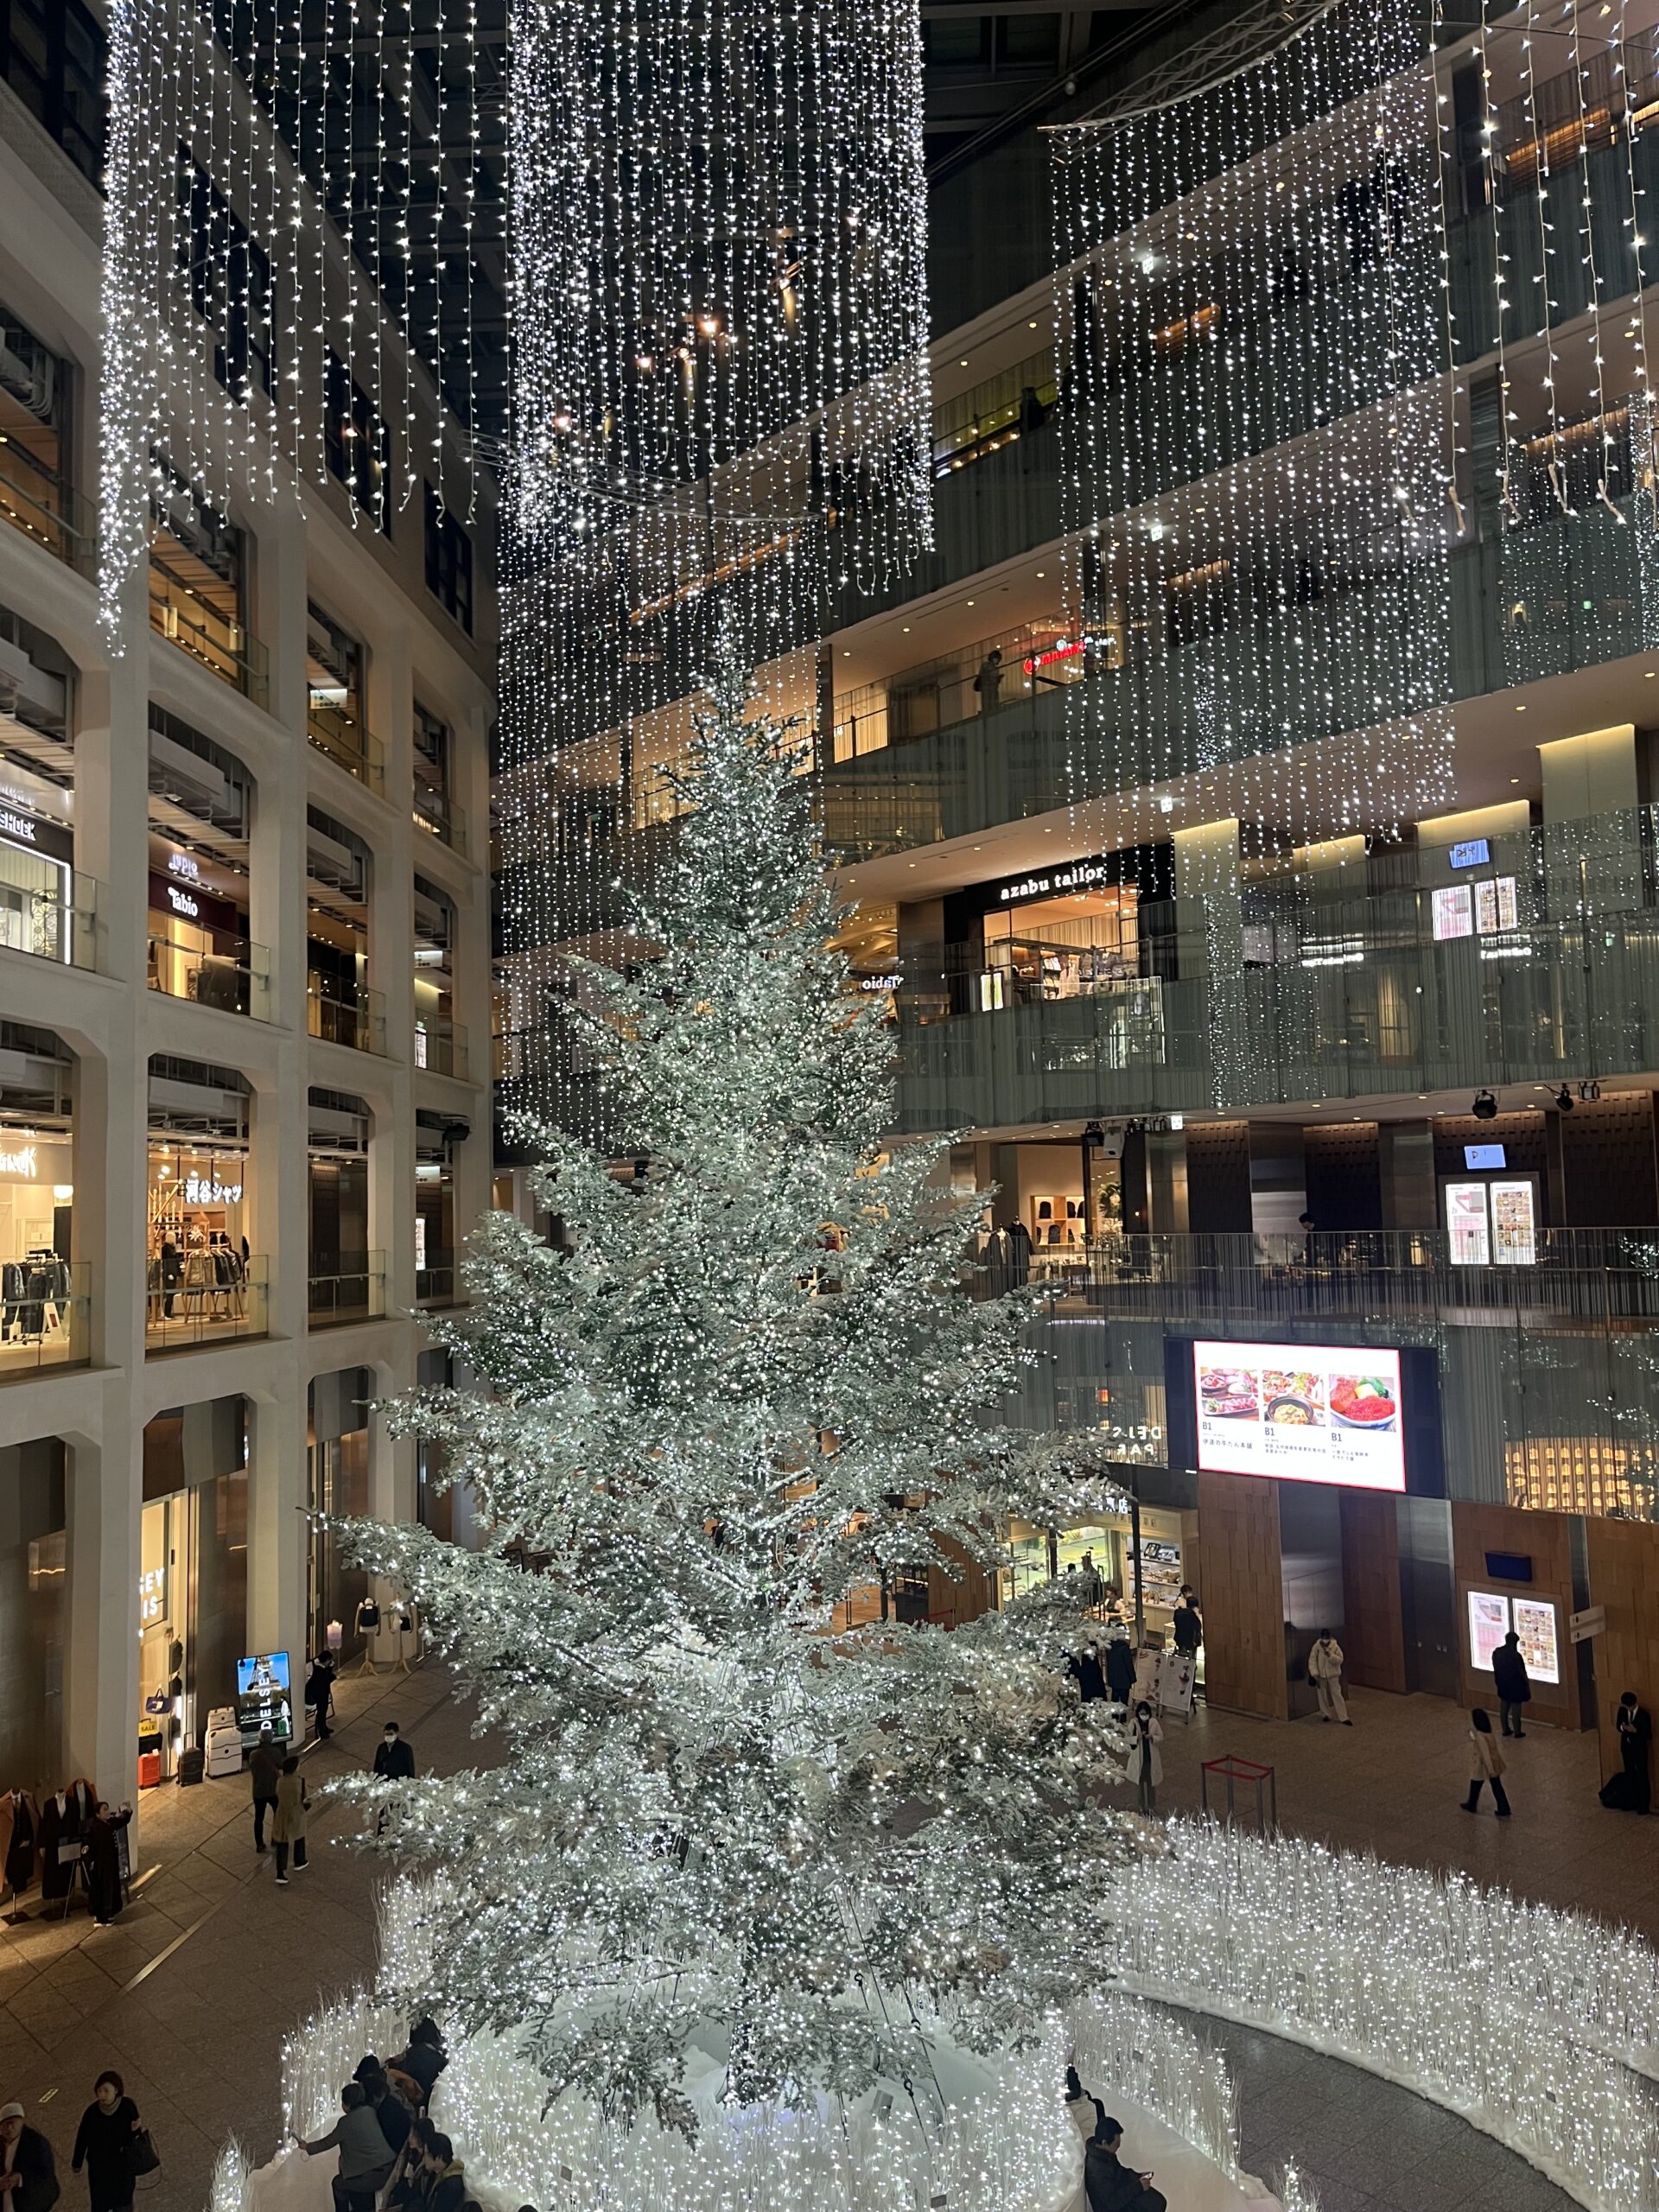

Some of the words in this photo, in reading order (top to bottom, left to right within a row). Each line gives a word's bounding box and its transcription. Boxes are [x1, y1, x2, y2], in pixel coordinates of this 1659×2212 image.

[1001, 878, 1050, 900] azabu
[1054, 865, 1105, 888] tailor
[167, 887, 199, 917] Tabio
[1203, 1421, 1212, 1431] B1
[1264, 1427, 1275, 1437] B1
[1331, 1432, 1343, 1442] B1
[258, 1661, 273, 1731] DELSEY
